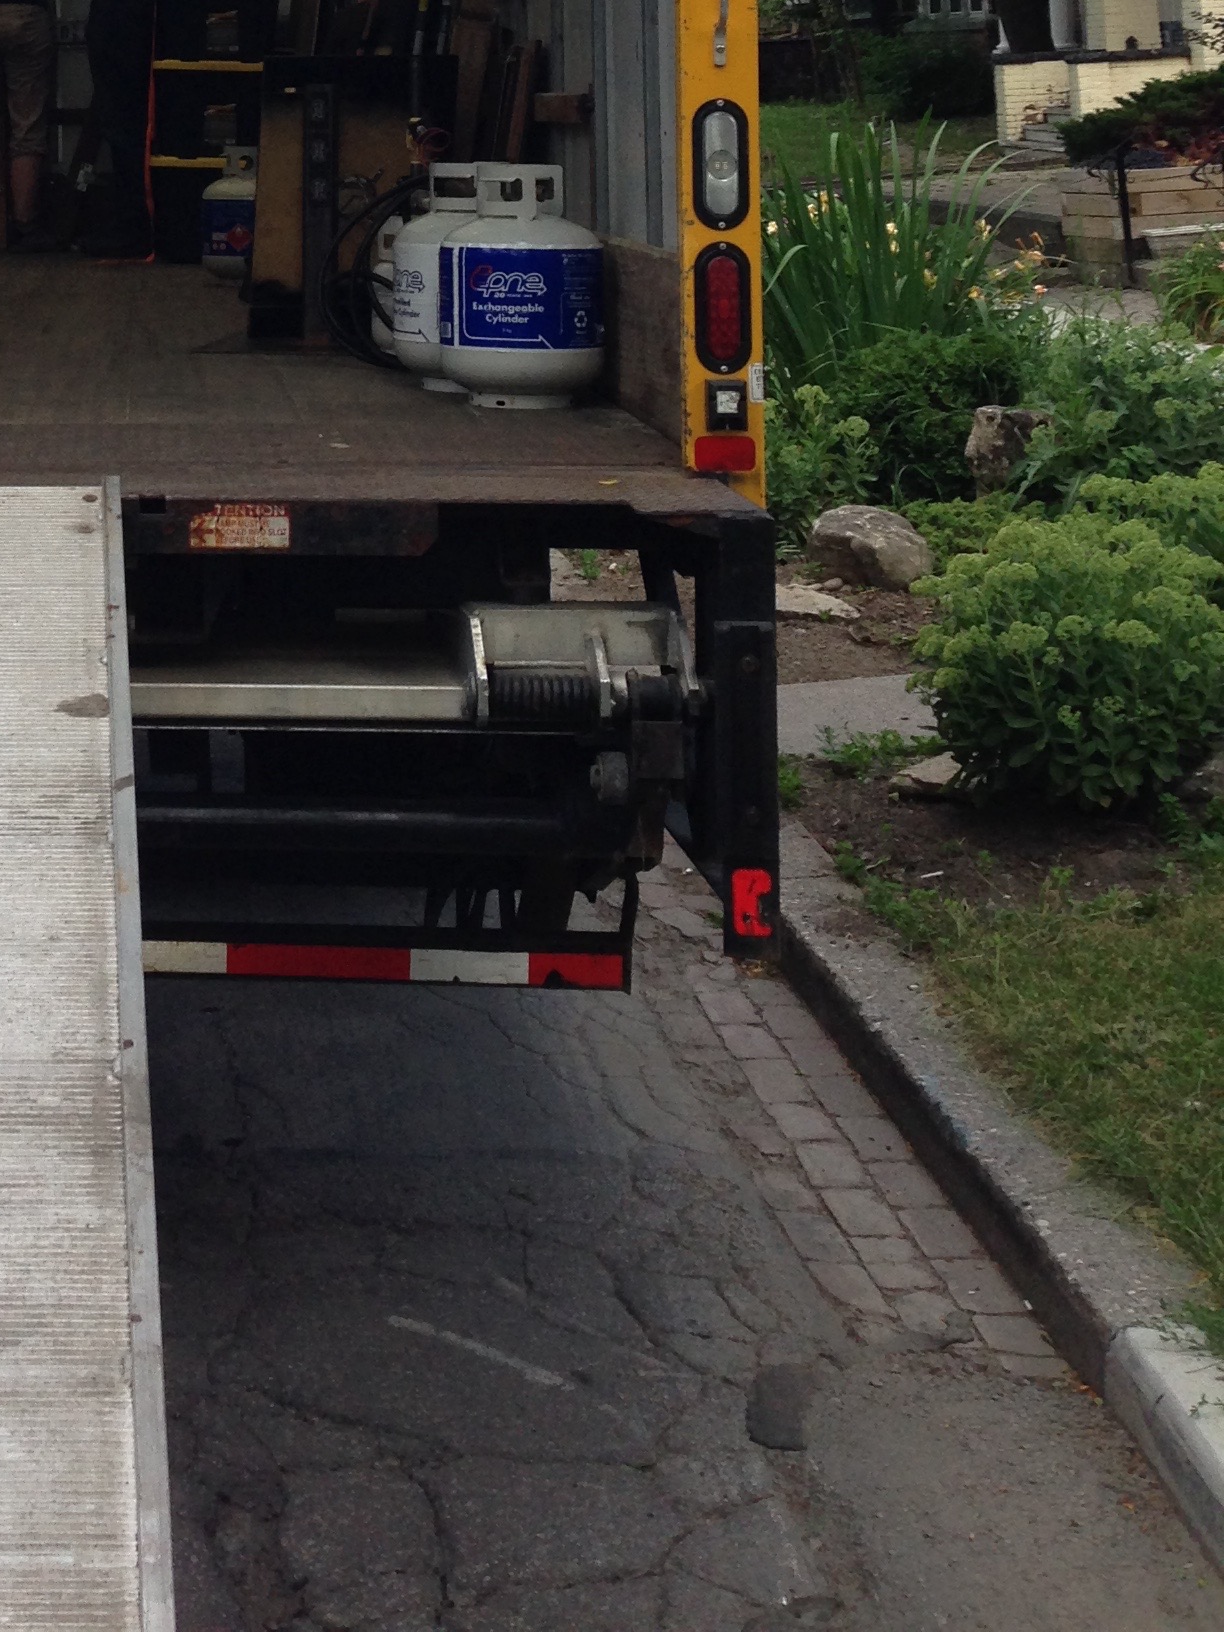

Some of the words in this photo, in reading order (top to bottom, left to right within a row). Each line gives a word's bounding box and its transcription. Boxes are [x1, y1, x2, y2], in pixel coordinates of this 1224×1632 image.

[473, 301, 545, 314] Exchangeable
[485, 313, 530, 325] Cylinder
[212, 504, 285, 516] TENTION
